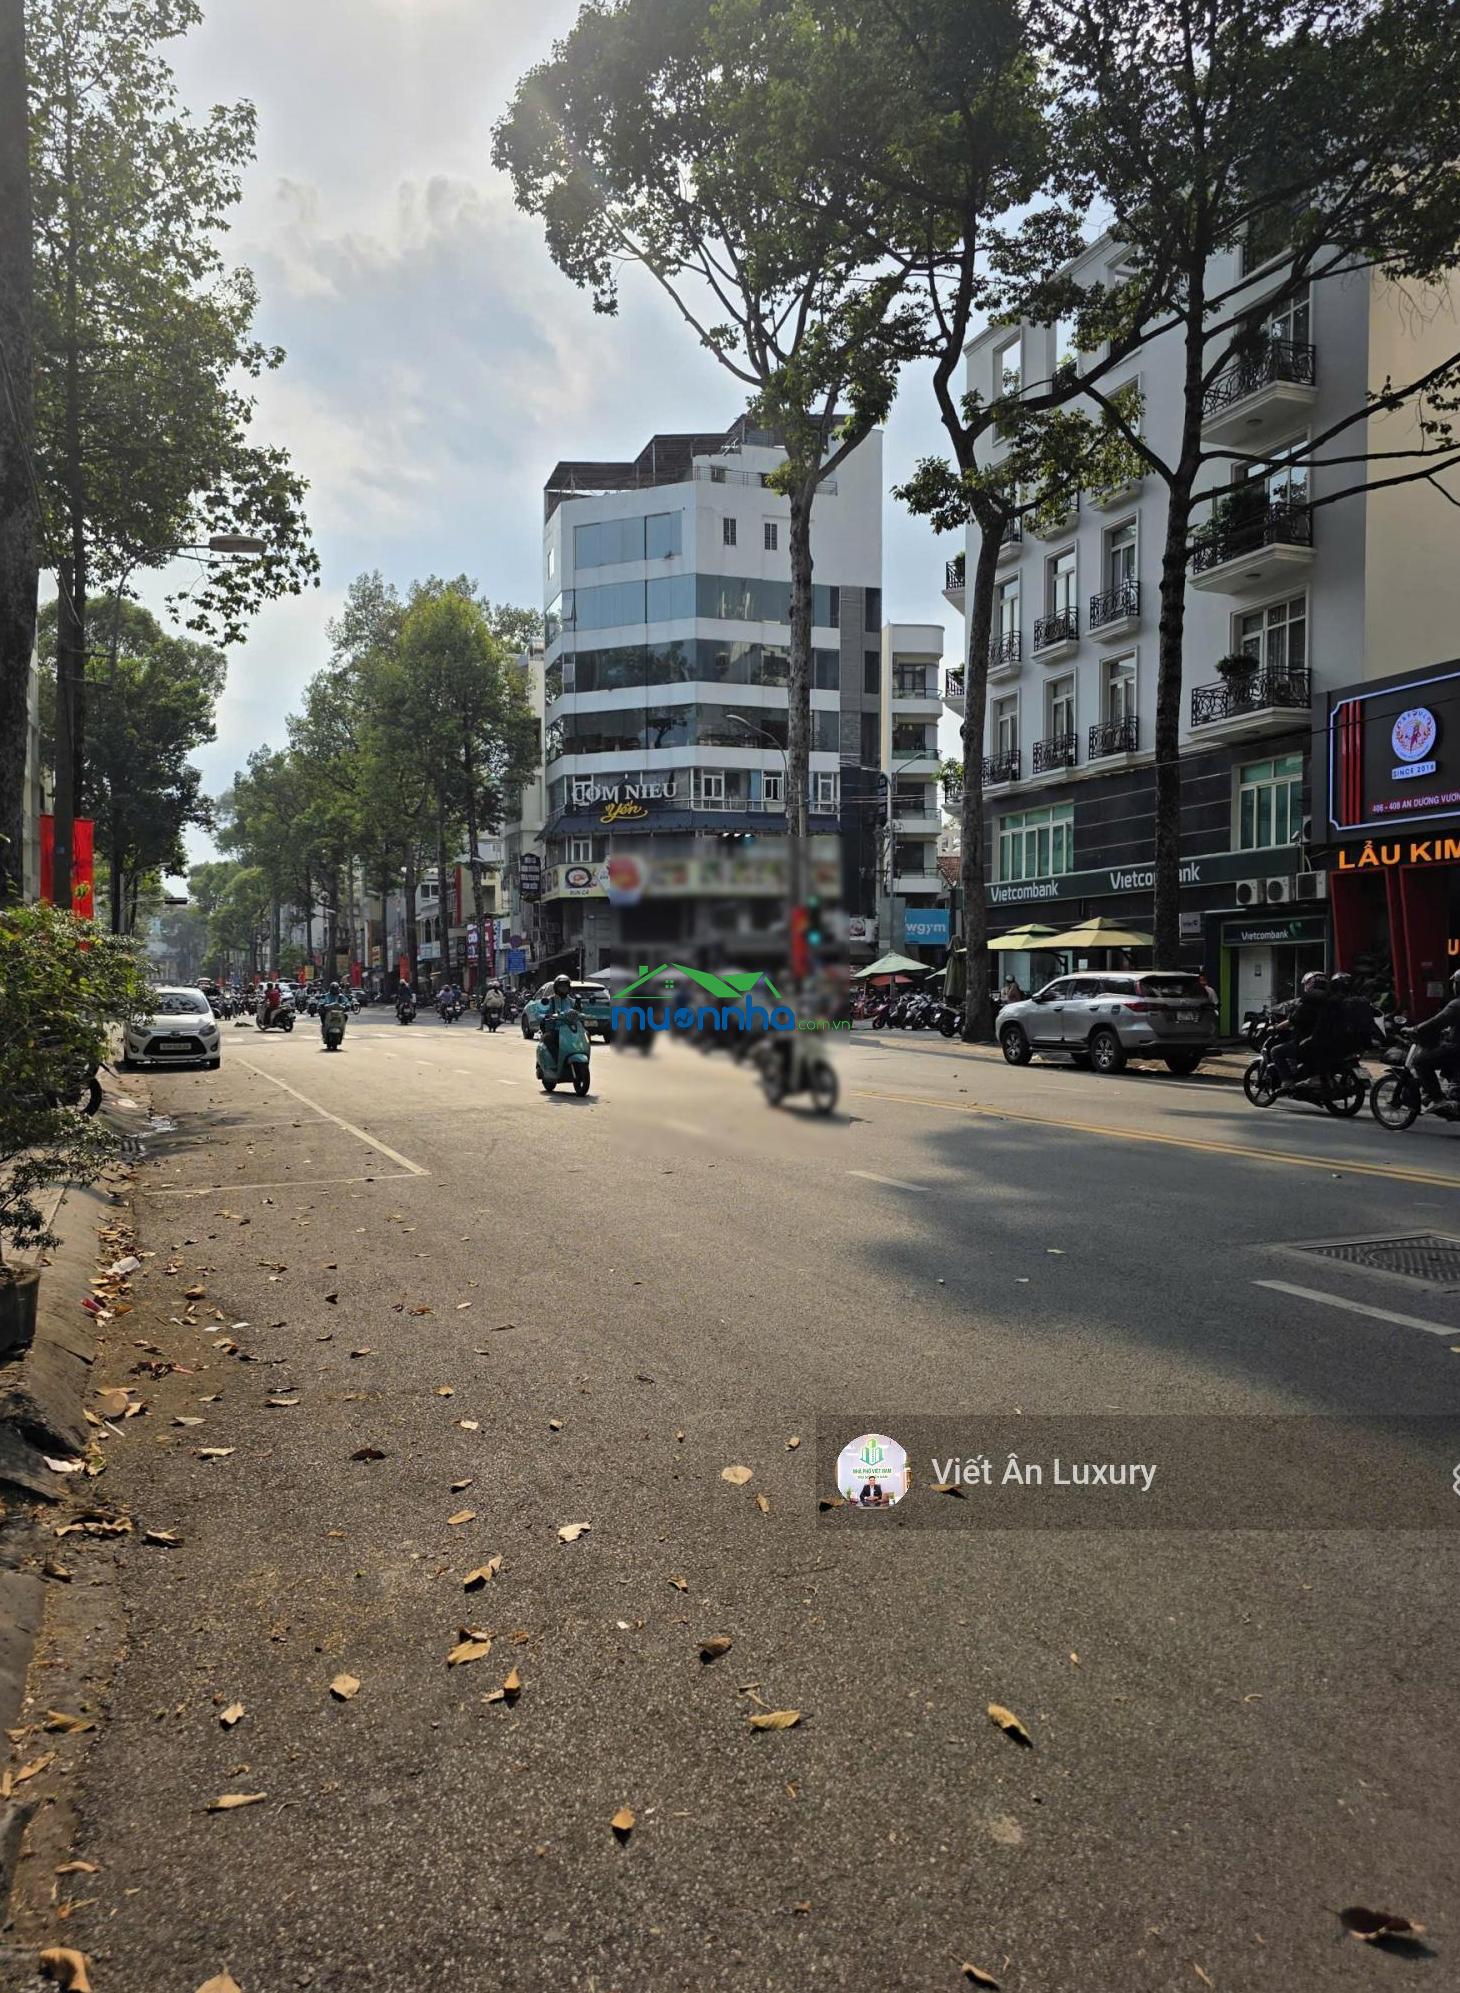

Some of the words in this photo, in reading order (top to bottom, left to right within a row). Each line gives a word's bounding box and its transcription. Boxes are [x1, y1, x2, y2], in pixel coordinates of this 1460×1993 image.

[1393, 767, 1414, 777] SINCE
[1402, 800, 1412, 808] AN
[1410, 839, 1460, 863] KIM
[991, 880, 1059, 902] Vietcombank
[1241, 929, 1289, 941] Vietcombank
